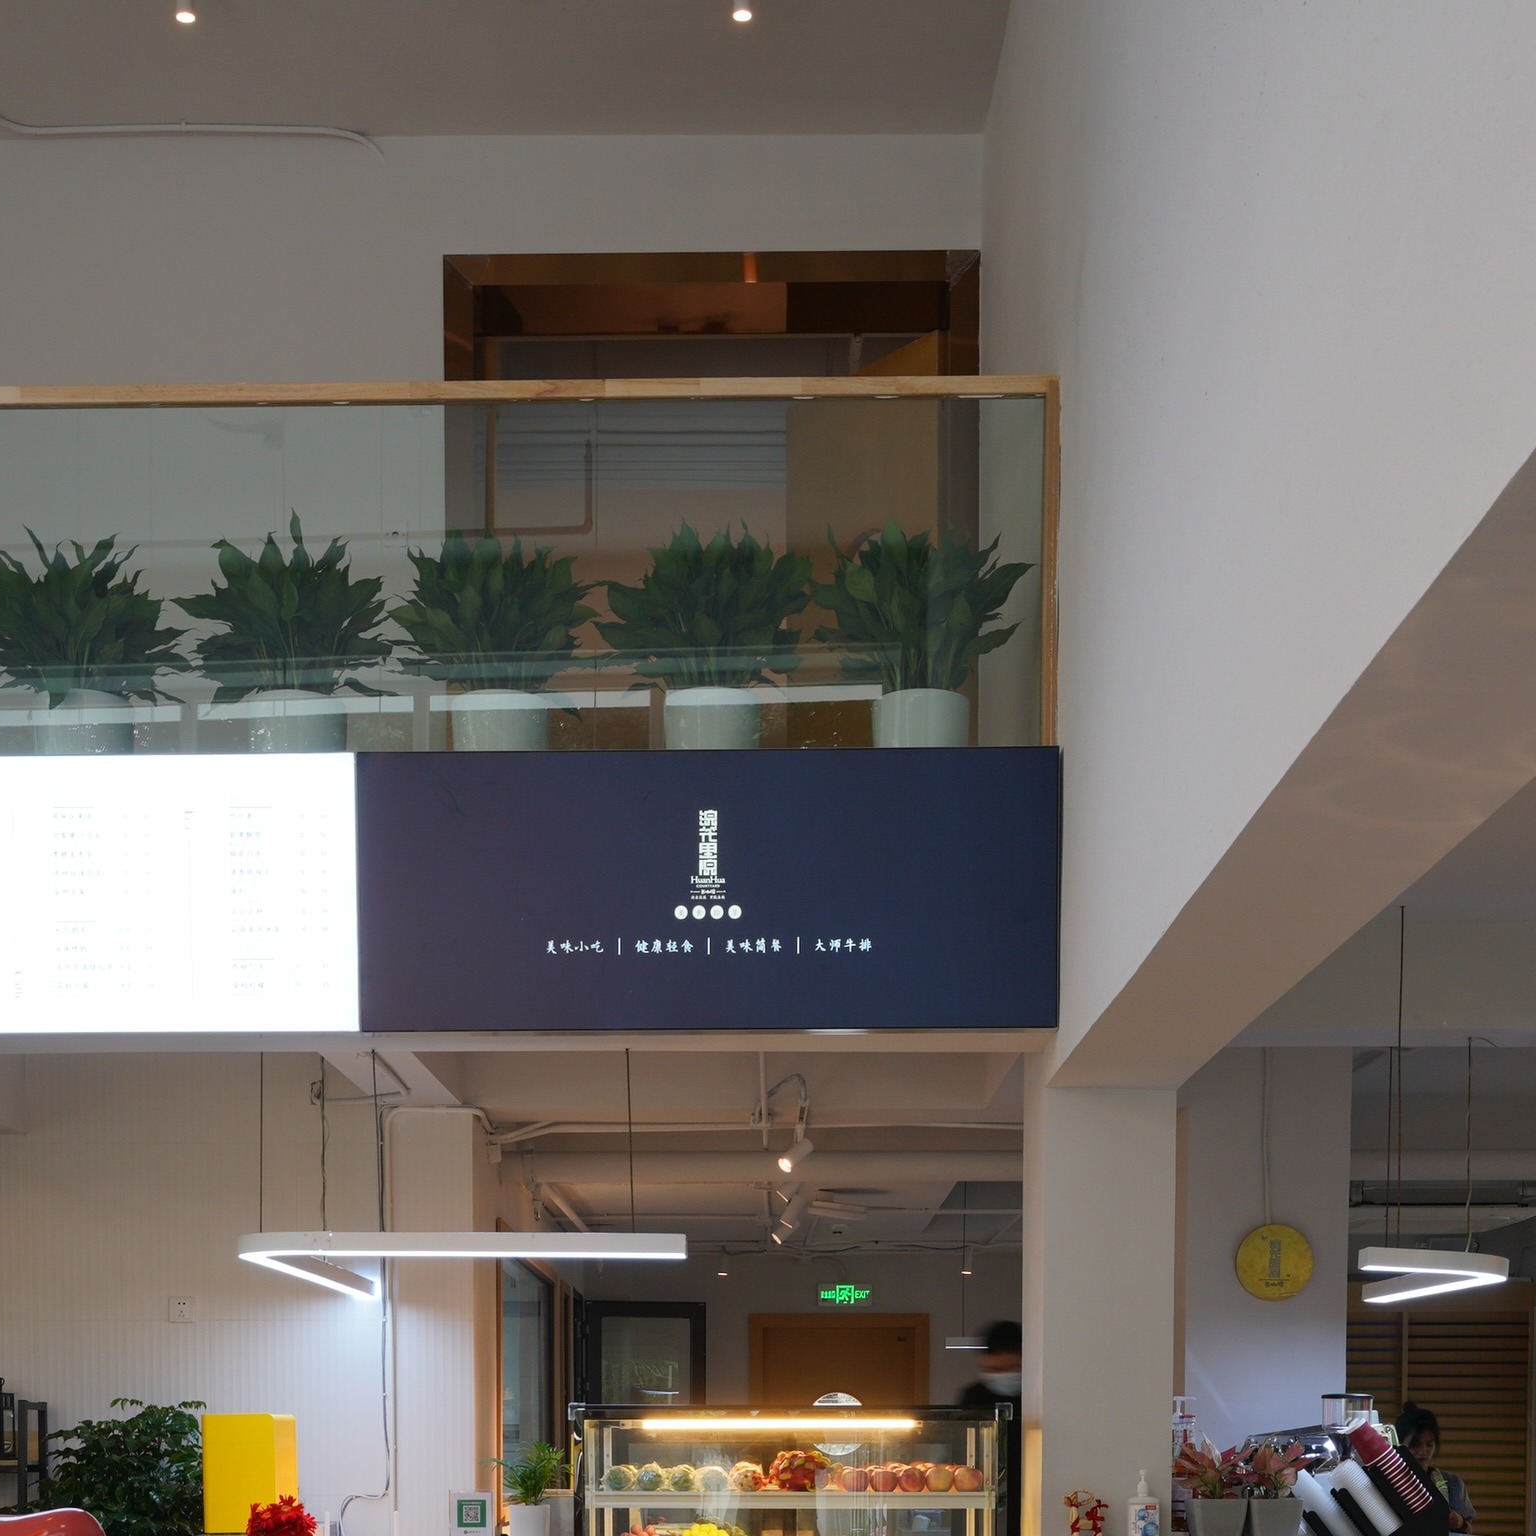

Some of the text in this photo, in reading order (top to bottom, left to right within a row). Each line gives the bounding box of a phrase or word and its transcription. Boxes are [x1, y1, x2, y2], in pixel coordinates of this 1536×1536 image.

[690, 876, 726, 884] HuanHua
[546, 938, 872, 954] 美味小吃 健康轻食 美味简餐 大师牛排
[855, 1290, 870, 1299] EXIT
